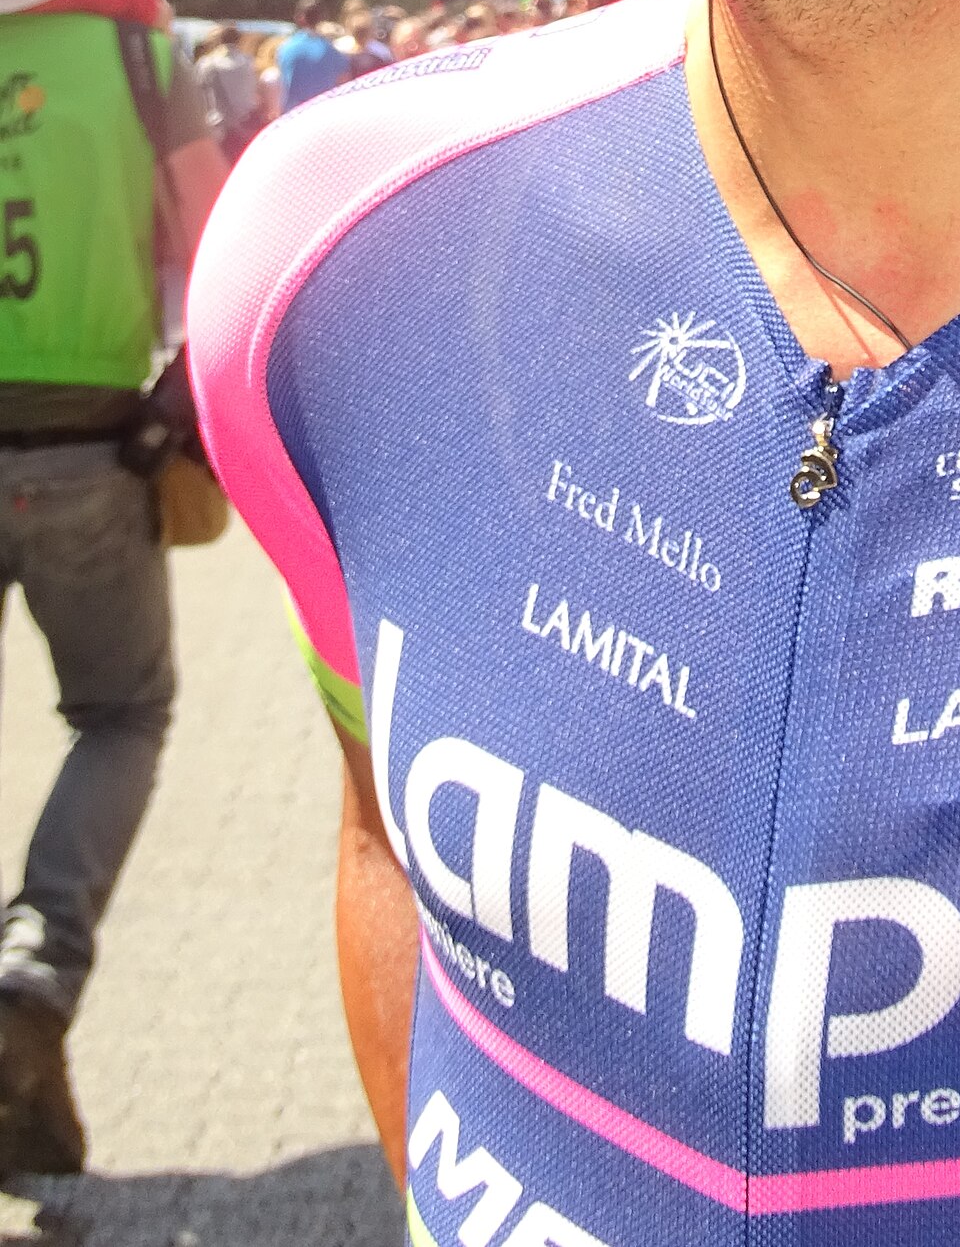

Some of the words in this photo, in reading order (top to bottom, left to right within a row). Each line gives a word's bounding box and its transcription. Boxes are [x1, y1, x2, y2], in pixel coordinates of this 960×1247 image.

[546, 460, 617, 531] Fred
[621, 504, 723, 593] Mello
[521, 583, 697, 719] LAMITAL
